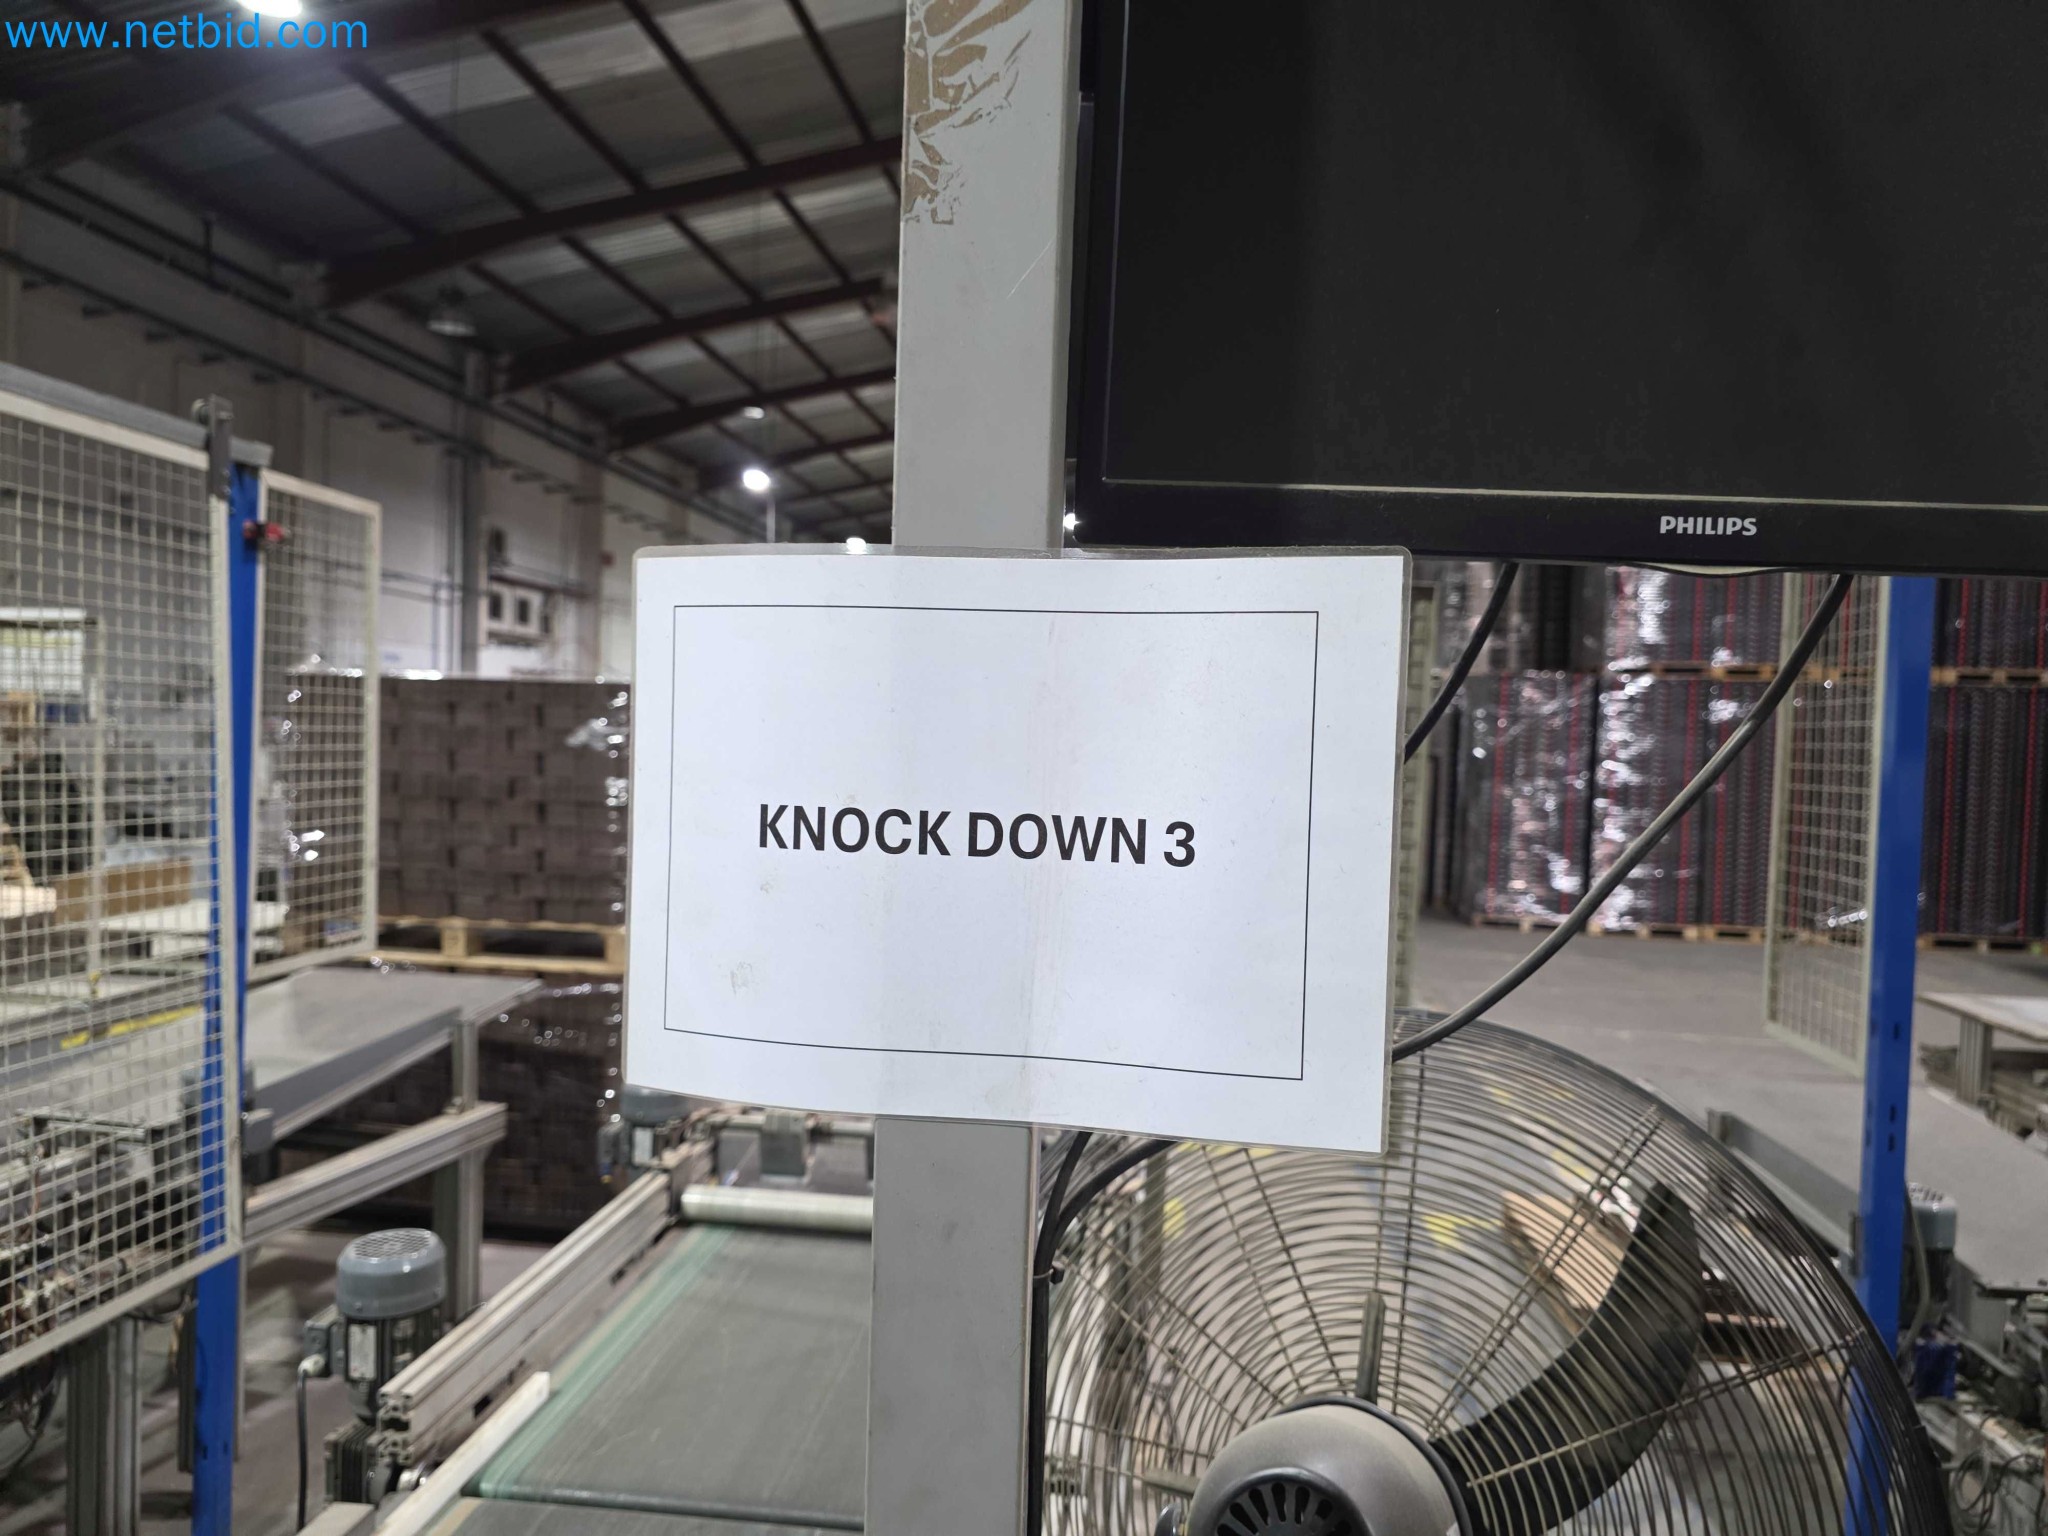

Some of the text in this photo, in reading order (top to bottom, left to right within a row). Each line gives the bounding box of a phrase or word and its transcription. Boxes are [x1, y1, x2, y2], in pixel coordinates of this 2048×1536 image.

[1659, 515, 1758, 537] PHILIPS
[759, 803, 1196, 868] KNOCK DOWN 3
